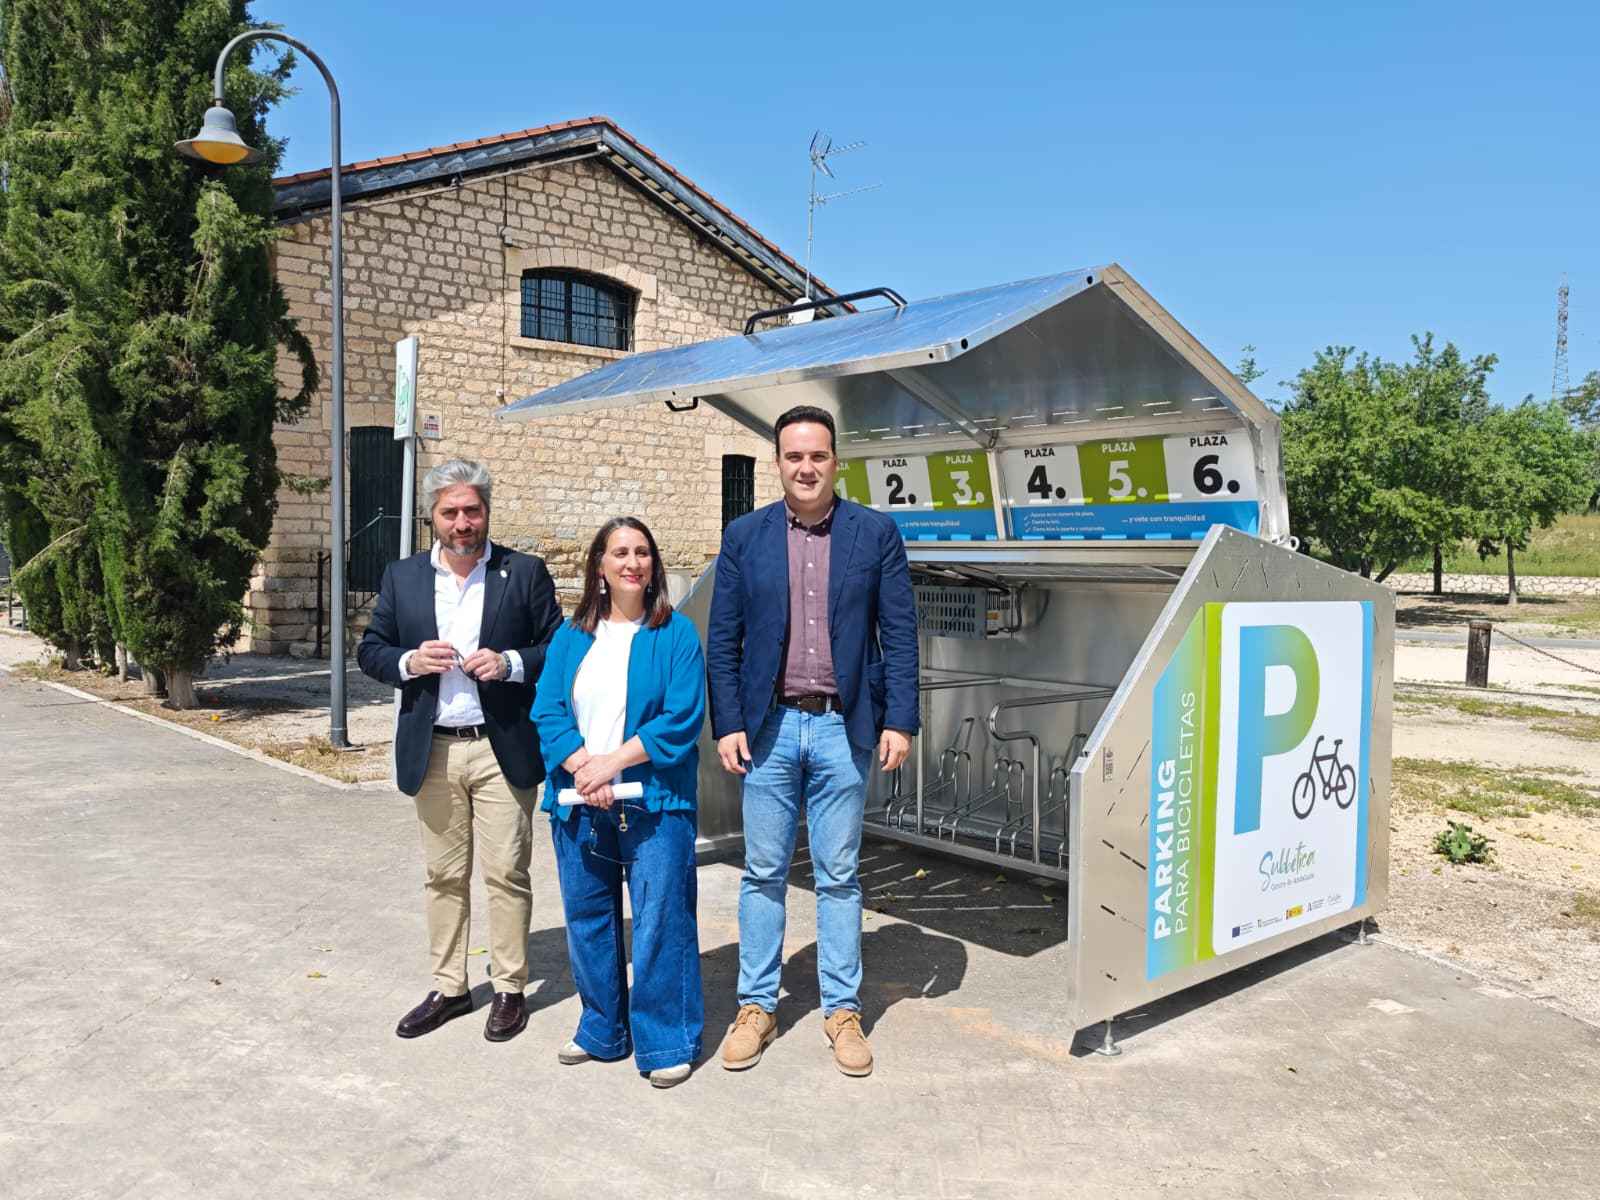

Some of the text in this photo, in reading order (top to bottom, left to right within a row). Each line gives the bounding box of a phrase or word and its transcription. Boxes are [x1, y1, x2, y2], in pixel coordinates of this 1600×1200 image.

[1024, 448, 1055, 459] PLAZA
[1102, 442, 1136, 454] PLAZA
[1190, 435, 1229, 448] PLAZA
[883, 458, 908, 468] PLAZA
[945, 455, 973, 465] PLAZA
[1193, 454, 1241, 495] 6.
[886, 473, 917, 504] 2.
[950, 470, 986, 504] 3.
[1027, 465, 1067, 500] 4.
[1107, 460, 1149, 498] 5.
[1163, 512, 1206, 523] tranquilidad
[1234, 624, 1320, 835] P
[1175, 691, 1196, 934] PARA BICICLETAS
[1154, 759, 1176, 939] PARKING
